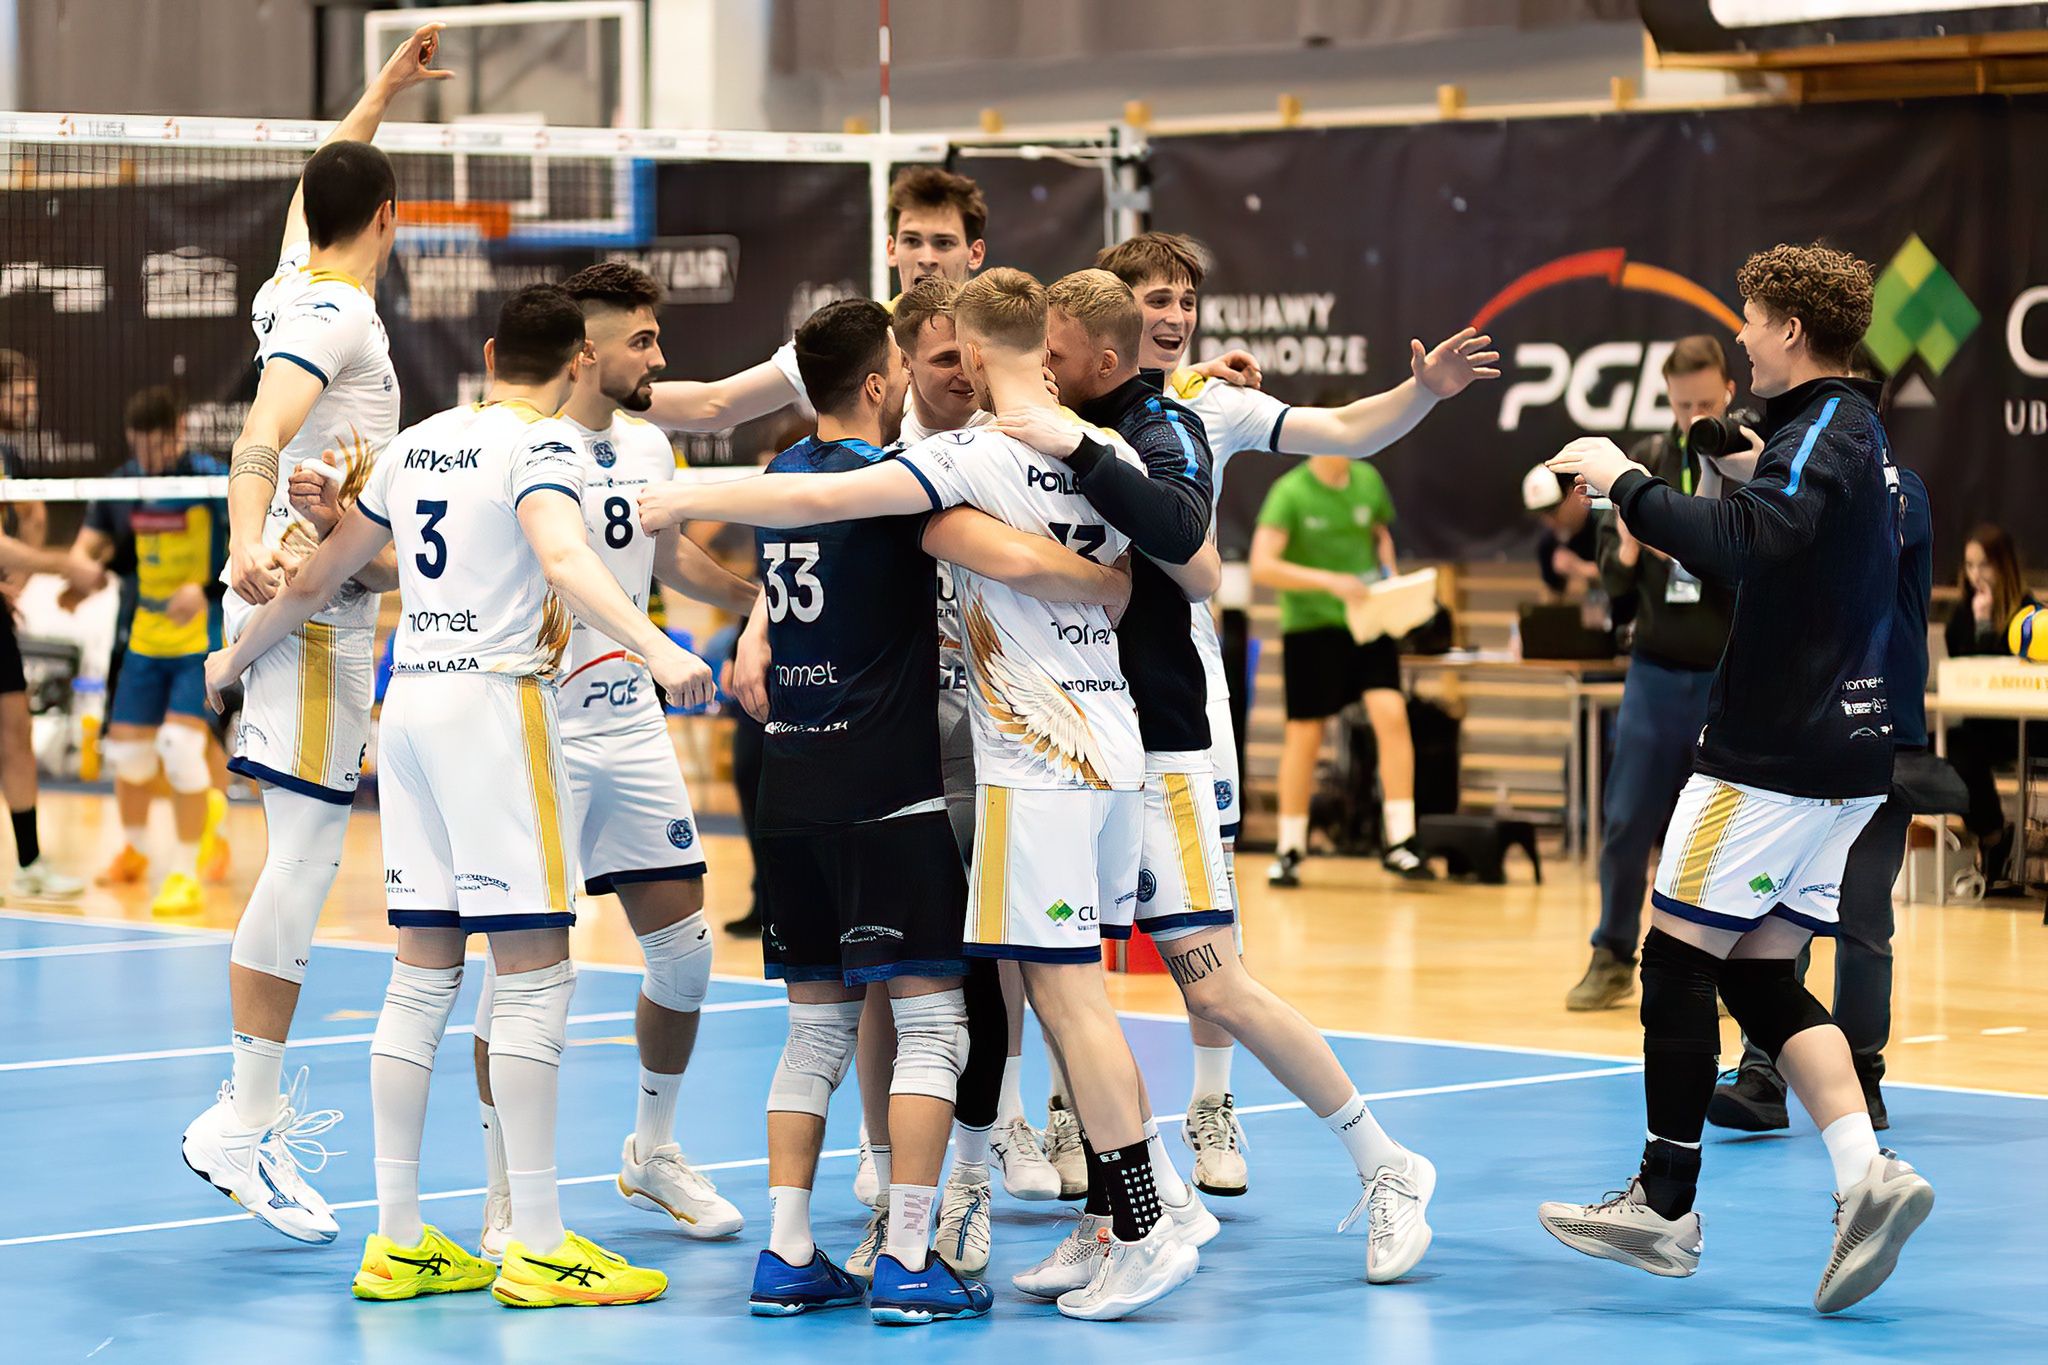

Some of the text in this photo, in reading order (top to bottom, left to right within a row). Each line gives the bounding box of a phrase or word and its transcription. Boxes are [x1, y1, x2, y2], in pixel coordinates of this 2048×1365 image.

[1201, 293, 1336, 333] KUJAWY
[415, 499, 448, 579] 3
[604, 496, 633, 549] 8
[763, 541, 824, 624] 33
[428, 657, 479, 672] PLAZA
[582, 676, 639, 708] PGE
